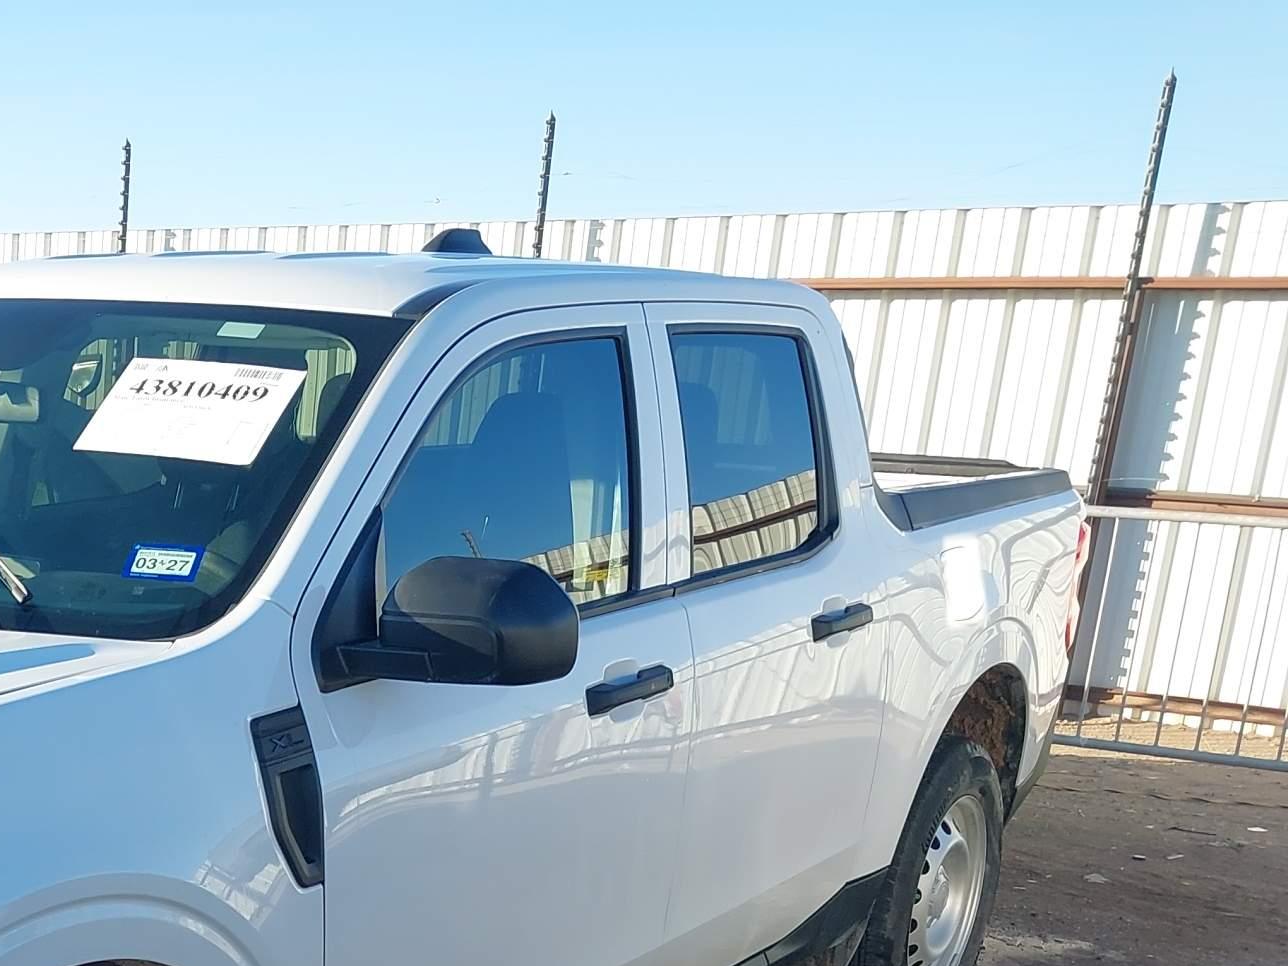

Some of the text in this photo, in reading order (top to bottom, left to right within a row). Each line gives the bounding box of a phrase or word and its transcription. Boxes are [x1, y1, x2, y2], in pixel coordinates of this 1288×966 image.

[129, 378, 269, 403] 43810409
[135, 557, 190, 572] 03 27
